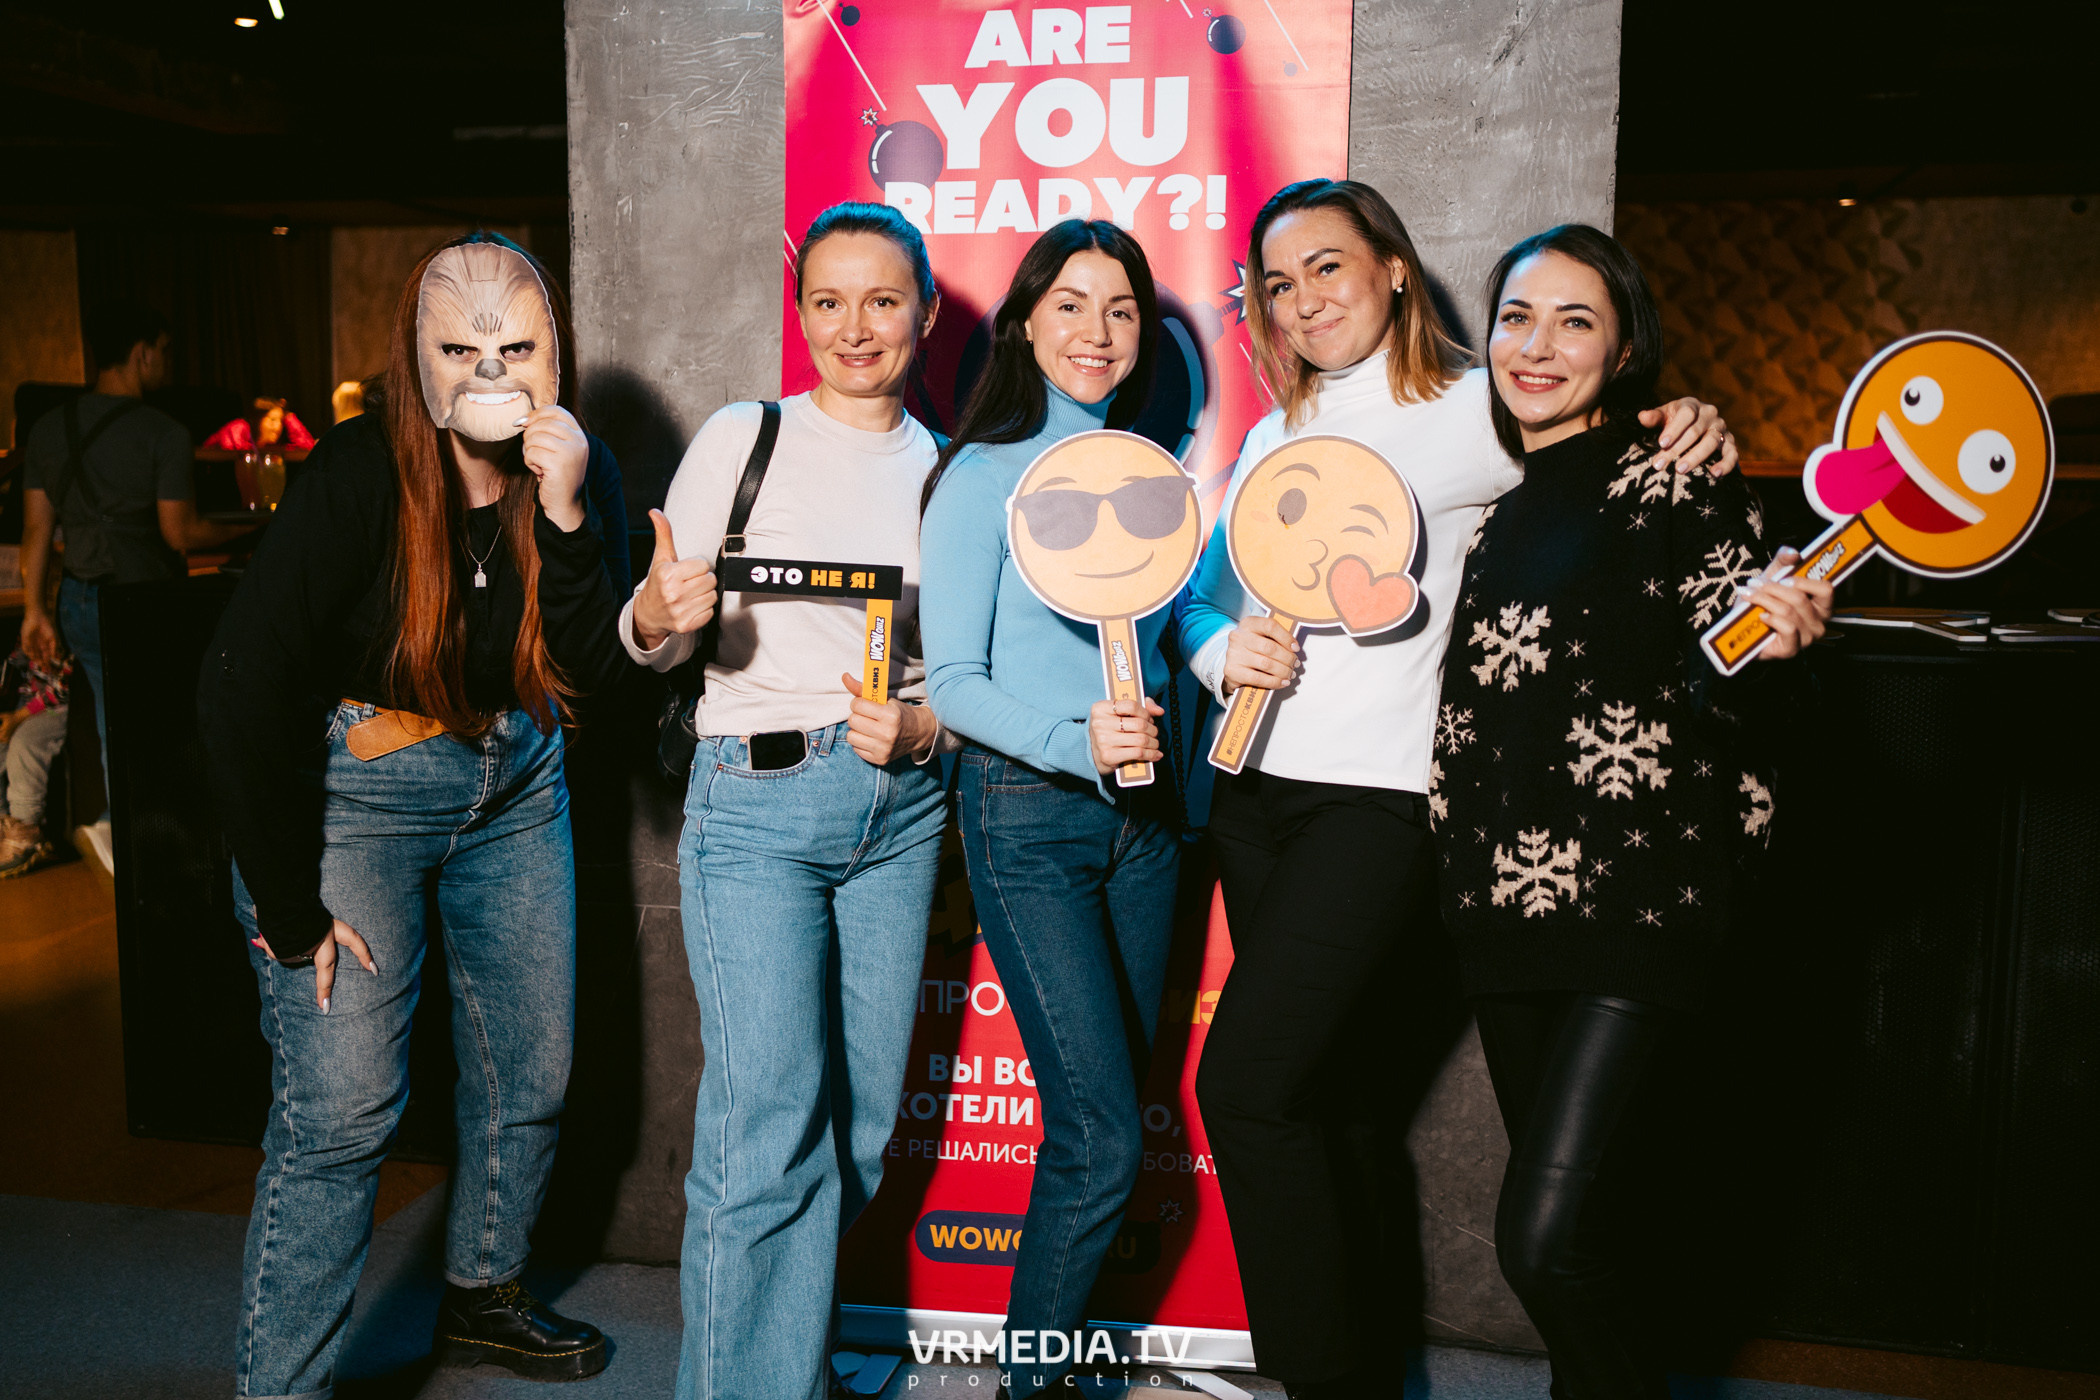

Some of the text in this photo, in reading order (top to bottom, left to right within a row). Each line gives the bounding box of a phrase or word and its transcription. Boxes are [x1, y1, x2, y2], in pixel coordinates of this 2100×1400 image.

[964, 5, 1132, 69] ARE
[916, 76, 1190, 170] YOU
[884, 173, 1228, 235] READY?!
[750, 565, 876, 590] ЭТО НЕ Я!
[928, 1053, 983, 1085] ВЫ
